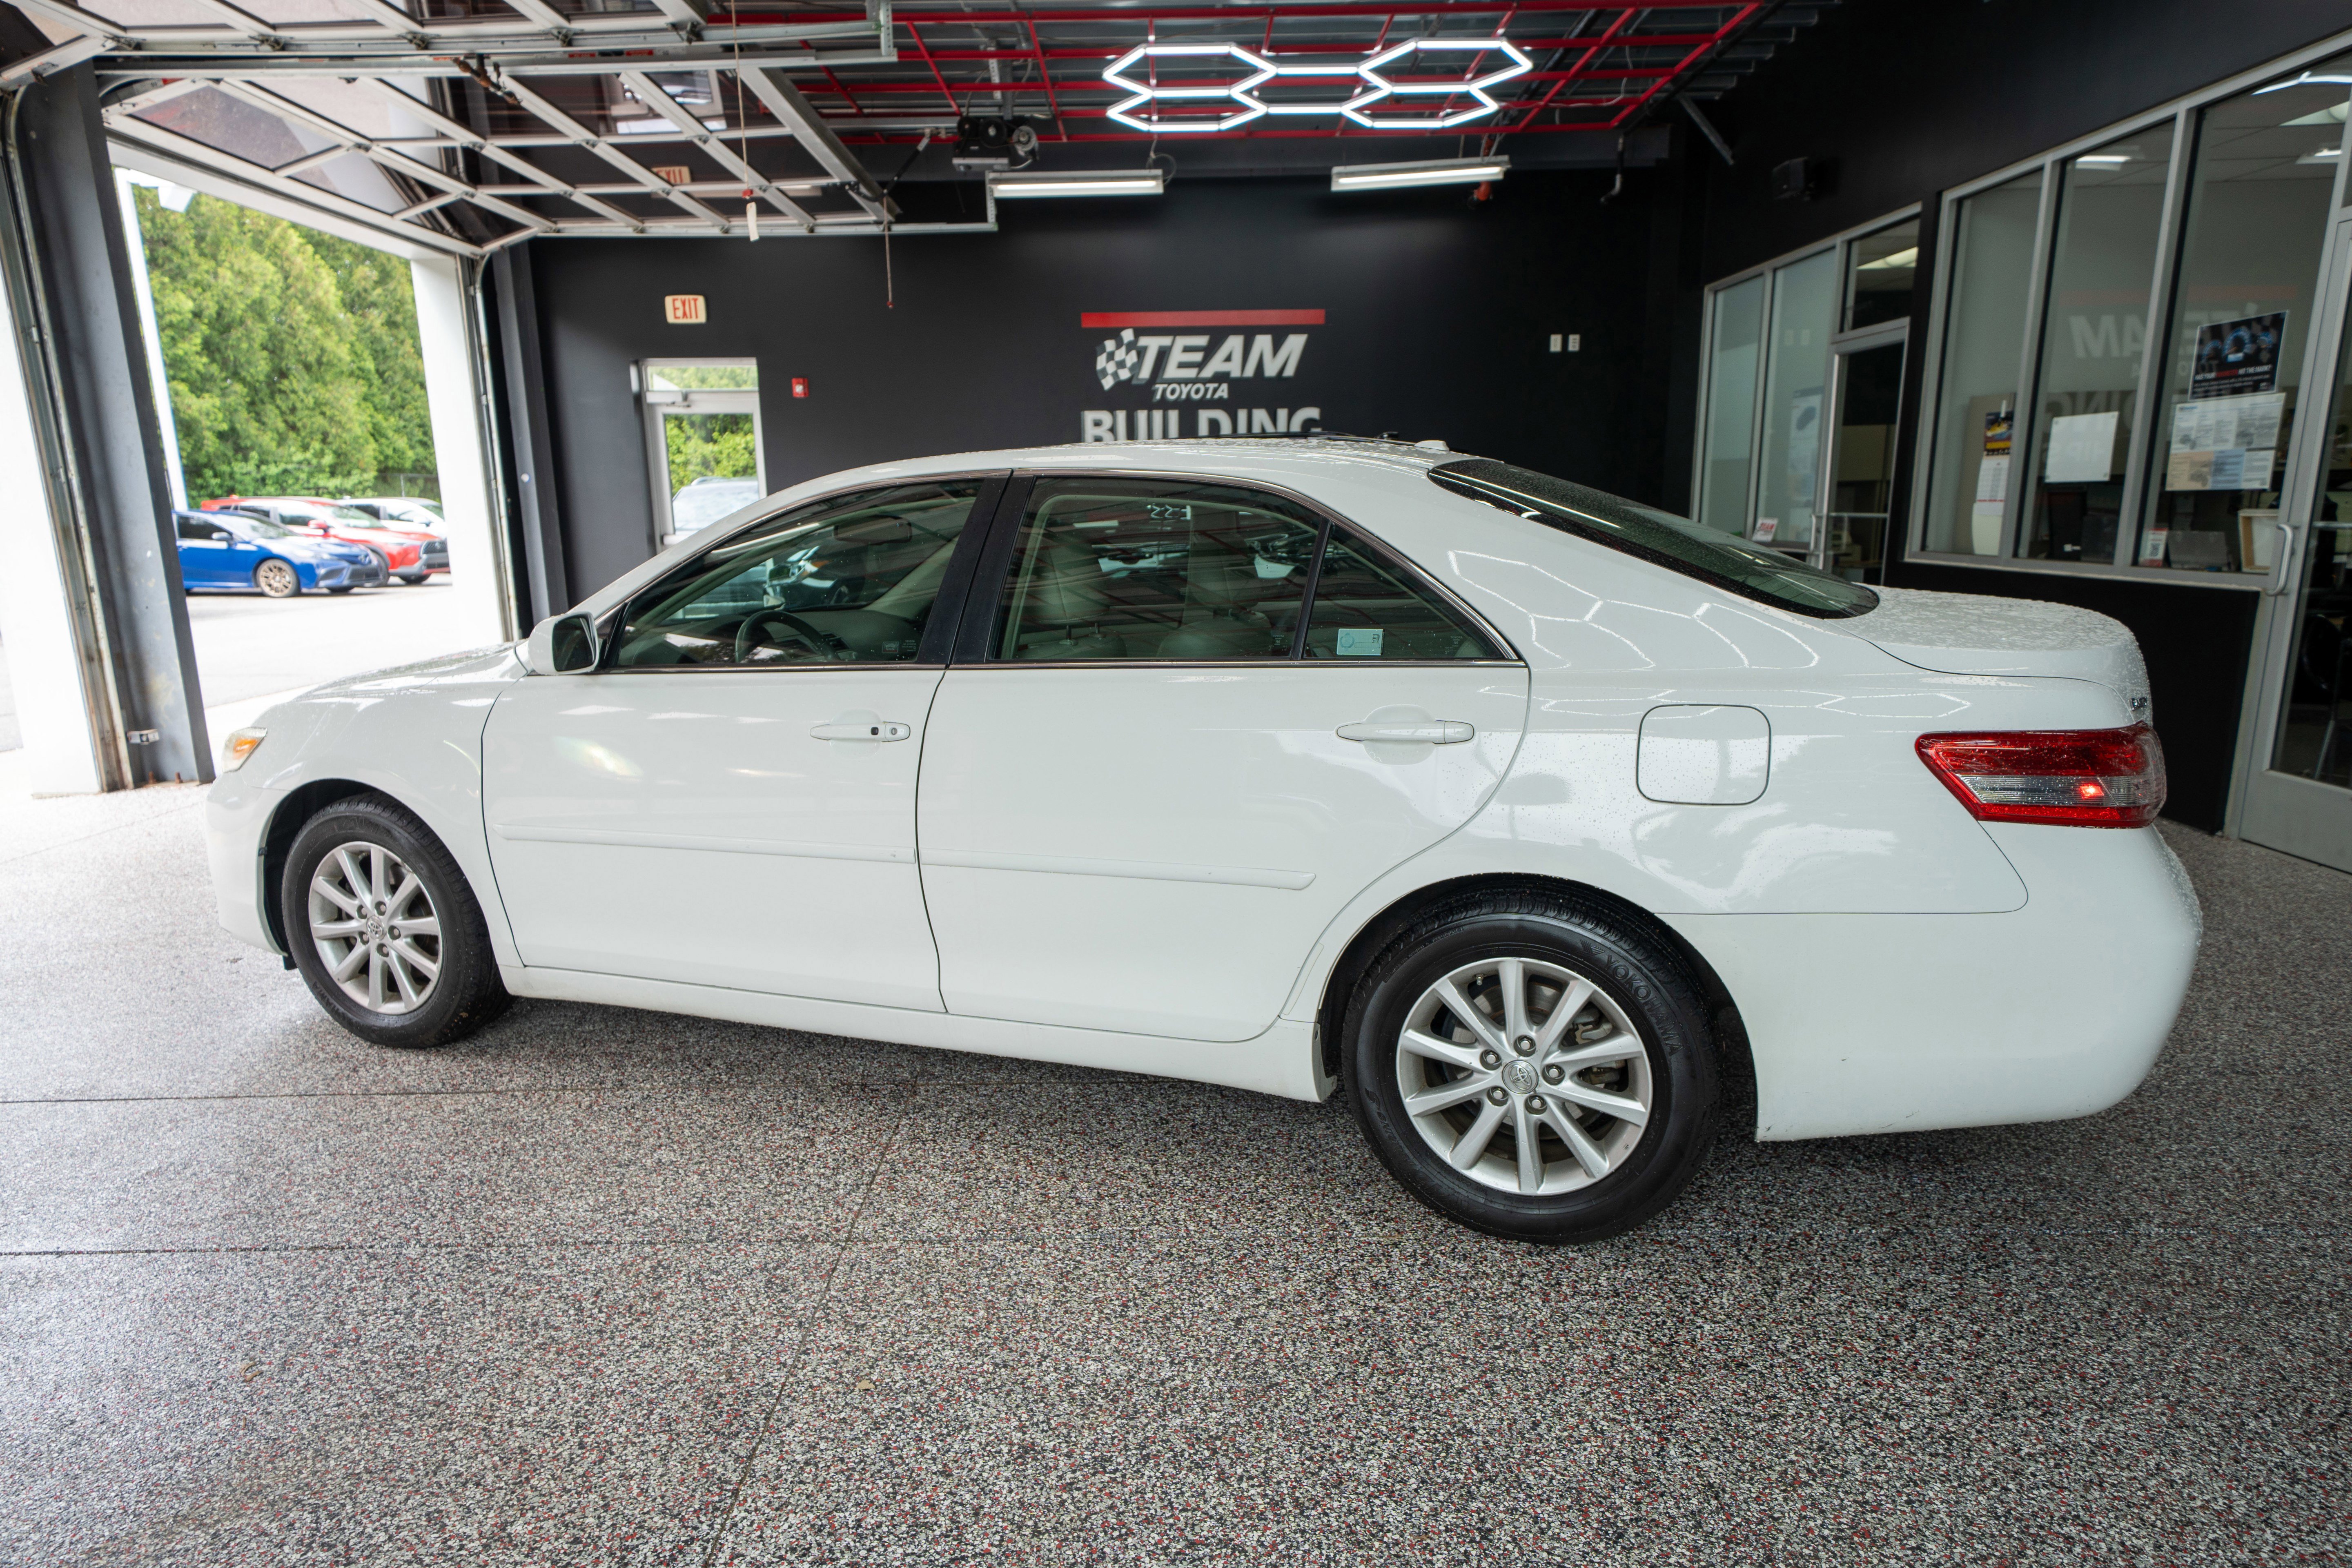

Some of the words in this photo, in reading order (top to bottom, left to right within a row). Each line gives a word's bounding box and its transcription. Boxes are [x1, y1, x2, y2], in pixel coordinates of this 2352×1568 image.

[672, 298, 698, 319] EXIT
[1135, 334, 1308, 379] TEAM
[1154, 383, 1229, 400] TOYOTA
[1083, 407, 1322, 443] BUILDING
[1604, 954, 1684, 1056] YOKOHAMA
